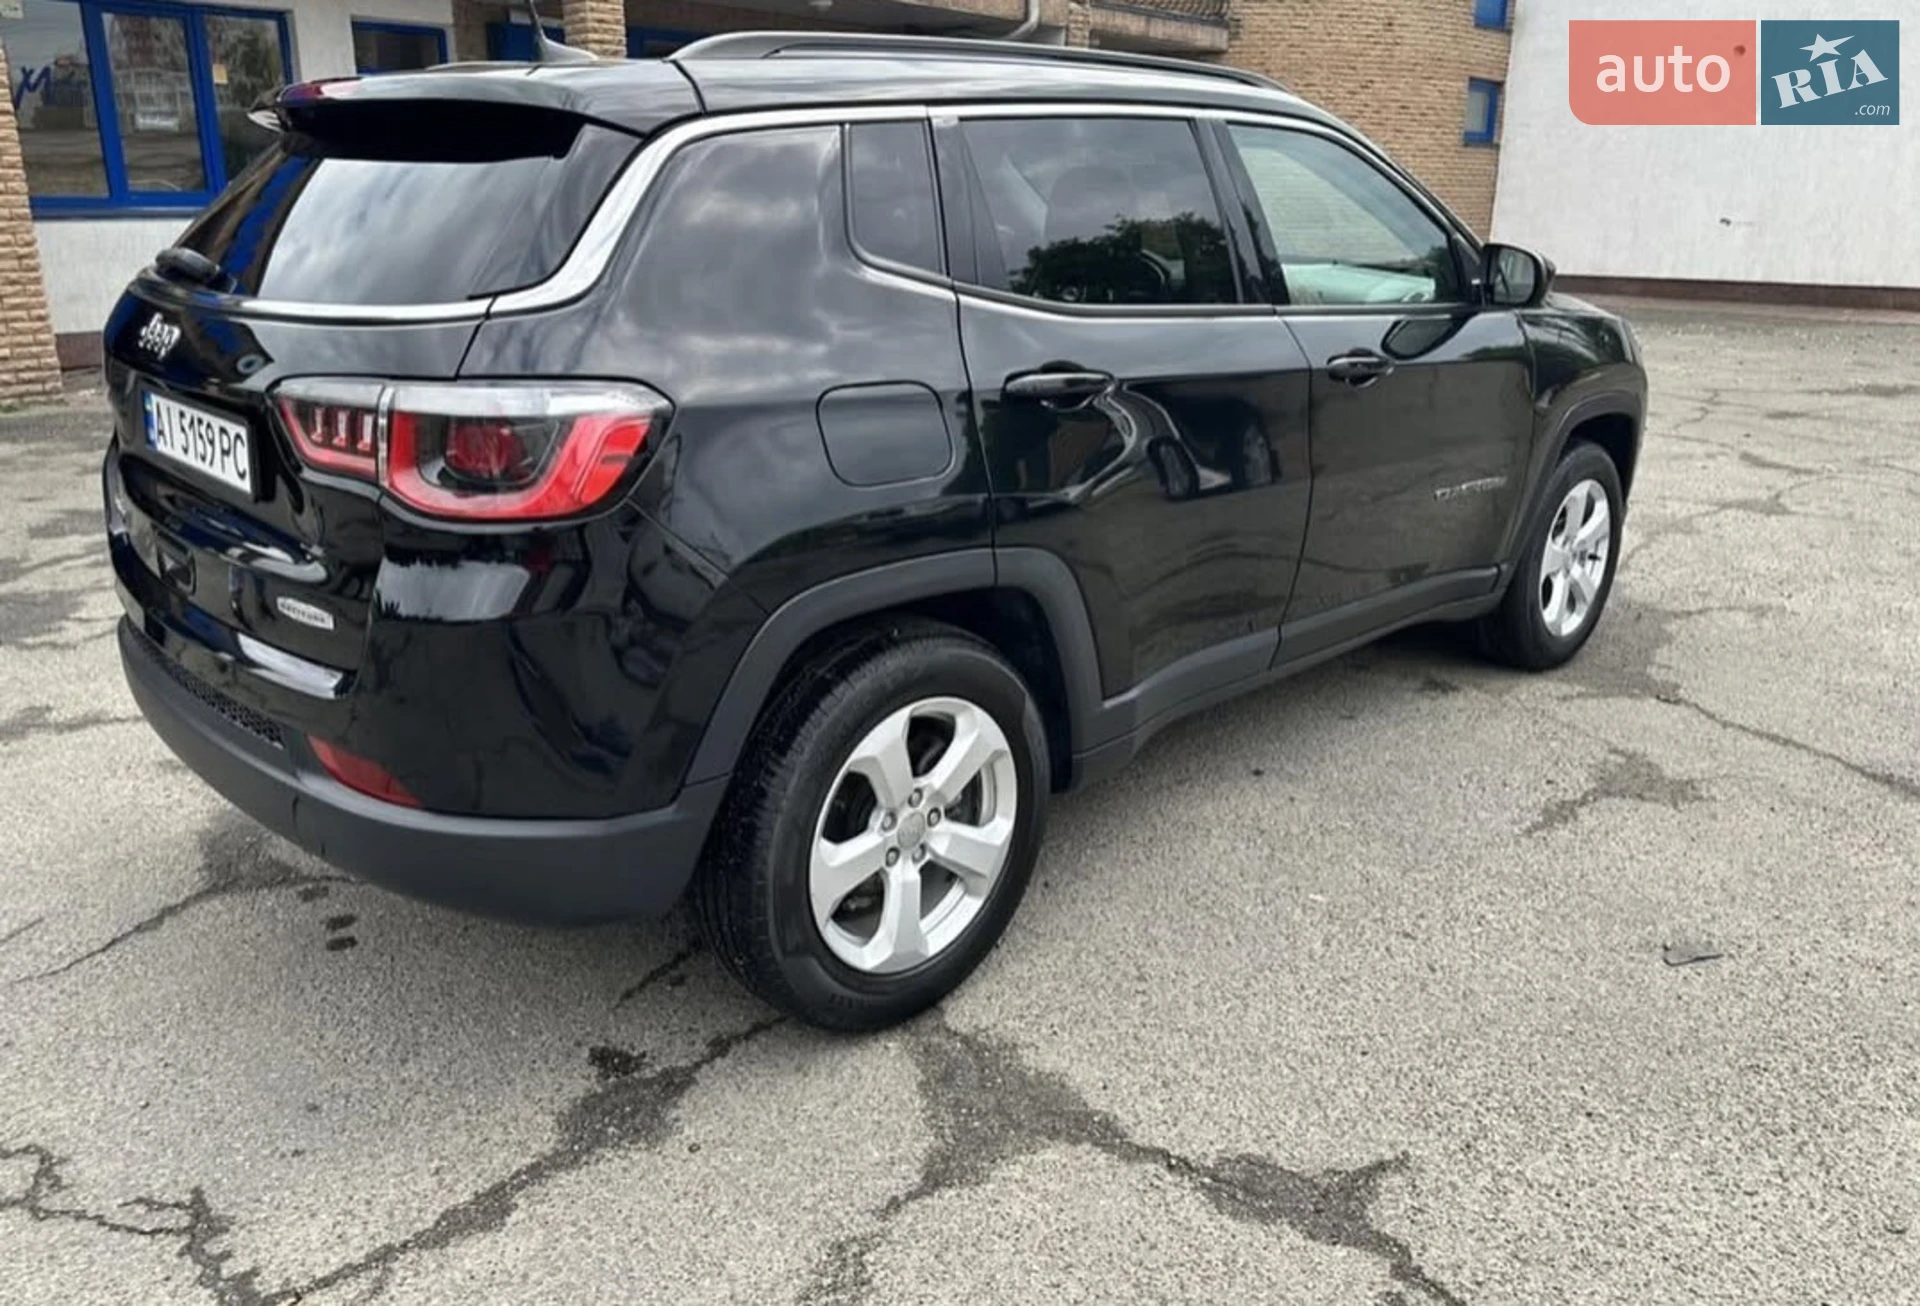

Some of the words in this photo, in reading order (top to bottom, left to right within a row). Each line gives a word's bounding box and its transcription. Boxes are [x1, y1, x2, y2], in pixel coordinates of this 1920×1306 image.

[156, 401, 175, 451] AI
[178, 409, 216, 469] 5159
[219, 425, 248, 482] PC
